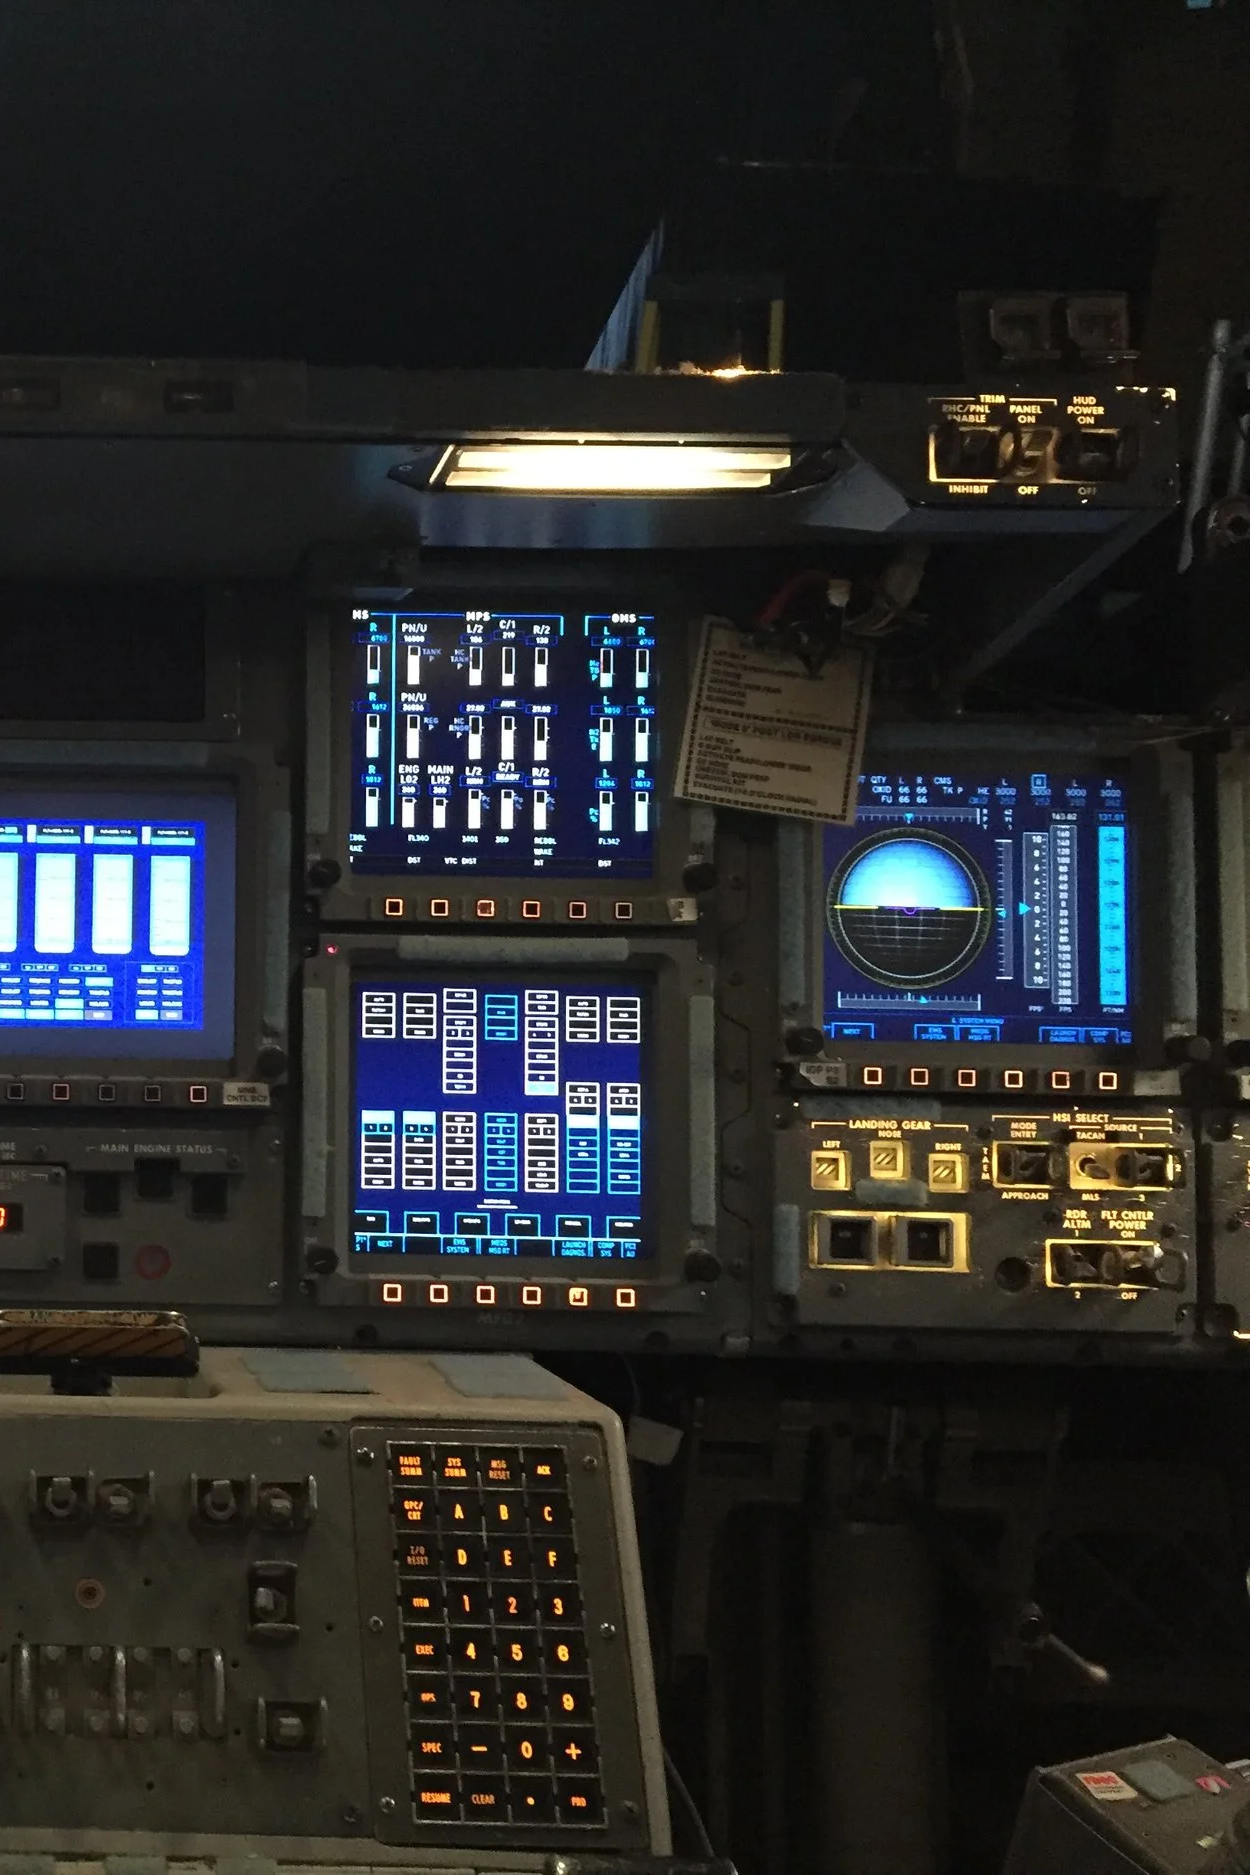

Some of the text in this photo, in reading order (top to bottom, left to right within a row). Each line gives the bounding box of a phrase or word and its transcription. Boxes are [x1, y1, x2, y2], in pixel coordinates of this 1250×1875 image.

[979, 395, 1006, 403] TRIM
[1072, 396, 1097, 405] HUD
[941, 404, 990, 413] RHC/PNL
[1010, 405, 1043, 414] PANEL
[1067, 406, 1105, 415] POWER
[1017, 415, 1036, 423] ON
[1078, 416, 1095, 424] ON
[948, 485, 989, 494] INHIBIT
[1017, 486, 1039, 495] OFF
[467, 624, 484, 634] L/2
[499, 620, 517, 629] C/1
[533, 625, 551, 635] R/2
[398, 765, 420, 774] ENG
[427, 765, 454, 774] MAIN
[1052, 1113, 1110, 1123] HSI SELECT
[849, 1120, 932, 1130] LANDING GEAR
[1010, 1122, 1038, 1130] MODE
[878, 1130, 902, 1138] NOSE
[1010, 1130, 1037, 1139] ENTRY
[1076, 1132, 1106, 1140] TACAN
[100, 1143, 213, 1154] MAIN ENGINE STATUS
[822, 1141, 841, 1149] LEFT
[935, 1143, 962, 1151] RIGHT
[1175, 1163, 1182, 1173] 2
[1001, 1191, 1049, 1200] APPROACH
[1101, 1210, 1120, 1221] FLT
[1063, 1220, 1091, 1229] ALTM
[1109, 1220, 1146, 1230] POWER
[1121, 1291, 1138, 1300] OFF
[454, 1504, 464, 1520] A
[499, 1504, 508, 1520] B
[544, 1506, 554, 1521] C
[457, 1548, 468, 1566] D
[503, 1550, 512, 1566] E
[548, 1550, 557, 1567] F
[463, 1595, 470, 1612] 1
[508, 1597, 517, 1614] 2
[554, 1598, 563, 1615] 3
[466, 1643, 476, 1660] 4
[512, 1644, 523, 1661] 5
[470, 1691, 480, 1709] 7
[521, 1742, 533, 1759] 0
